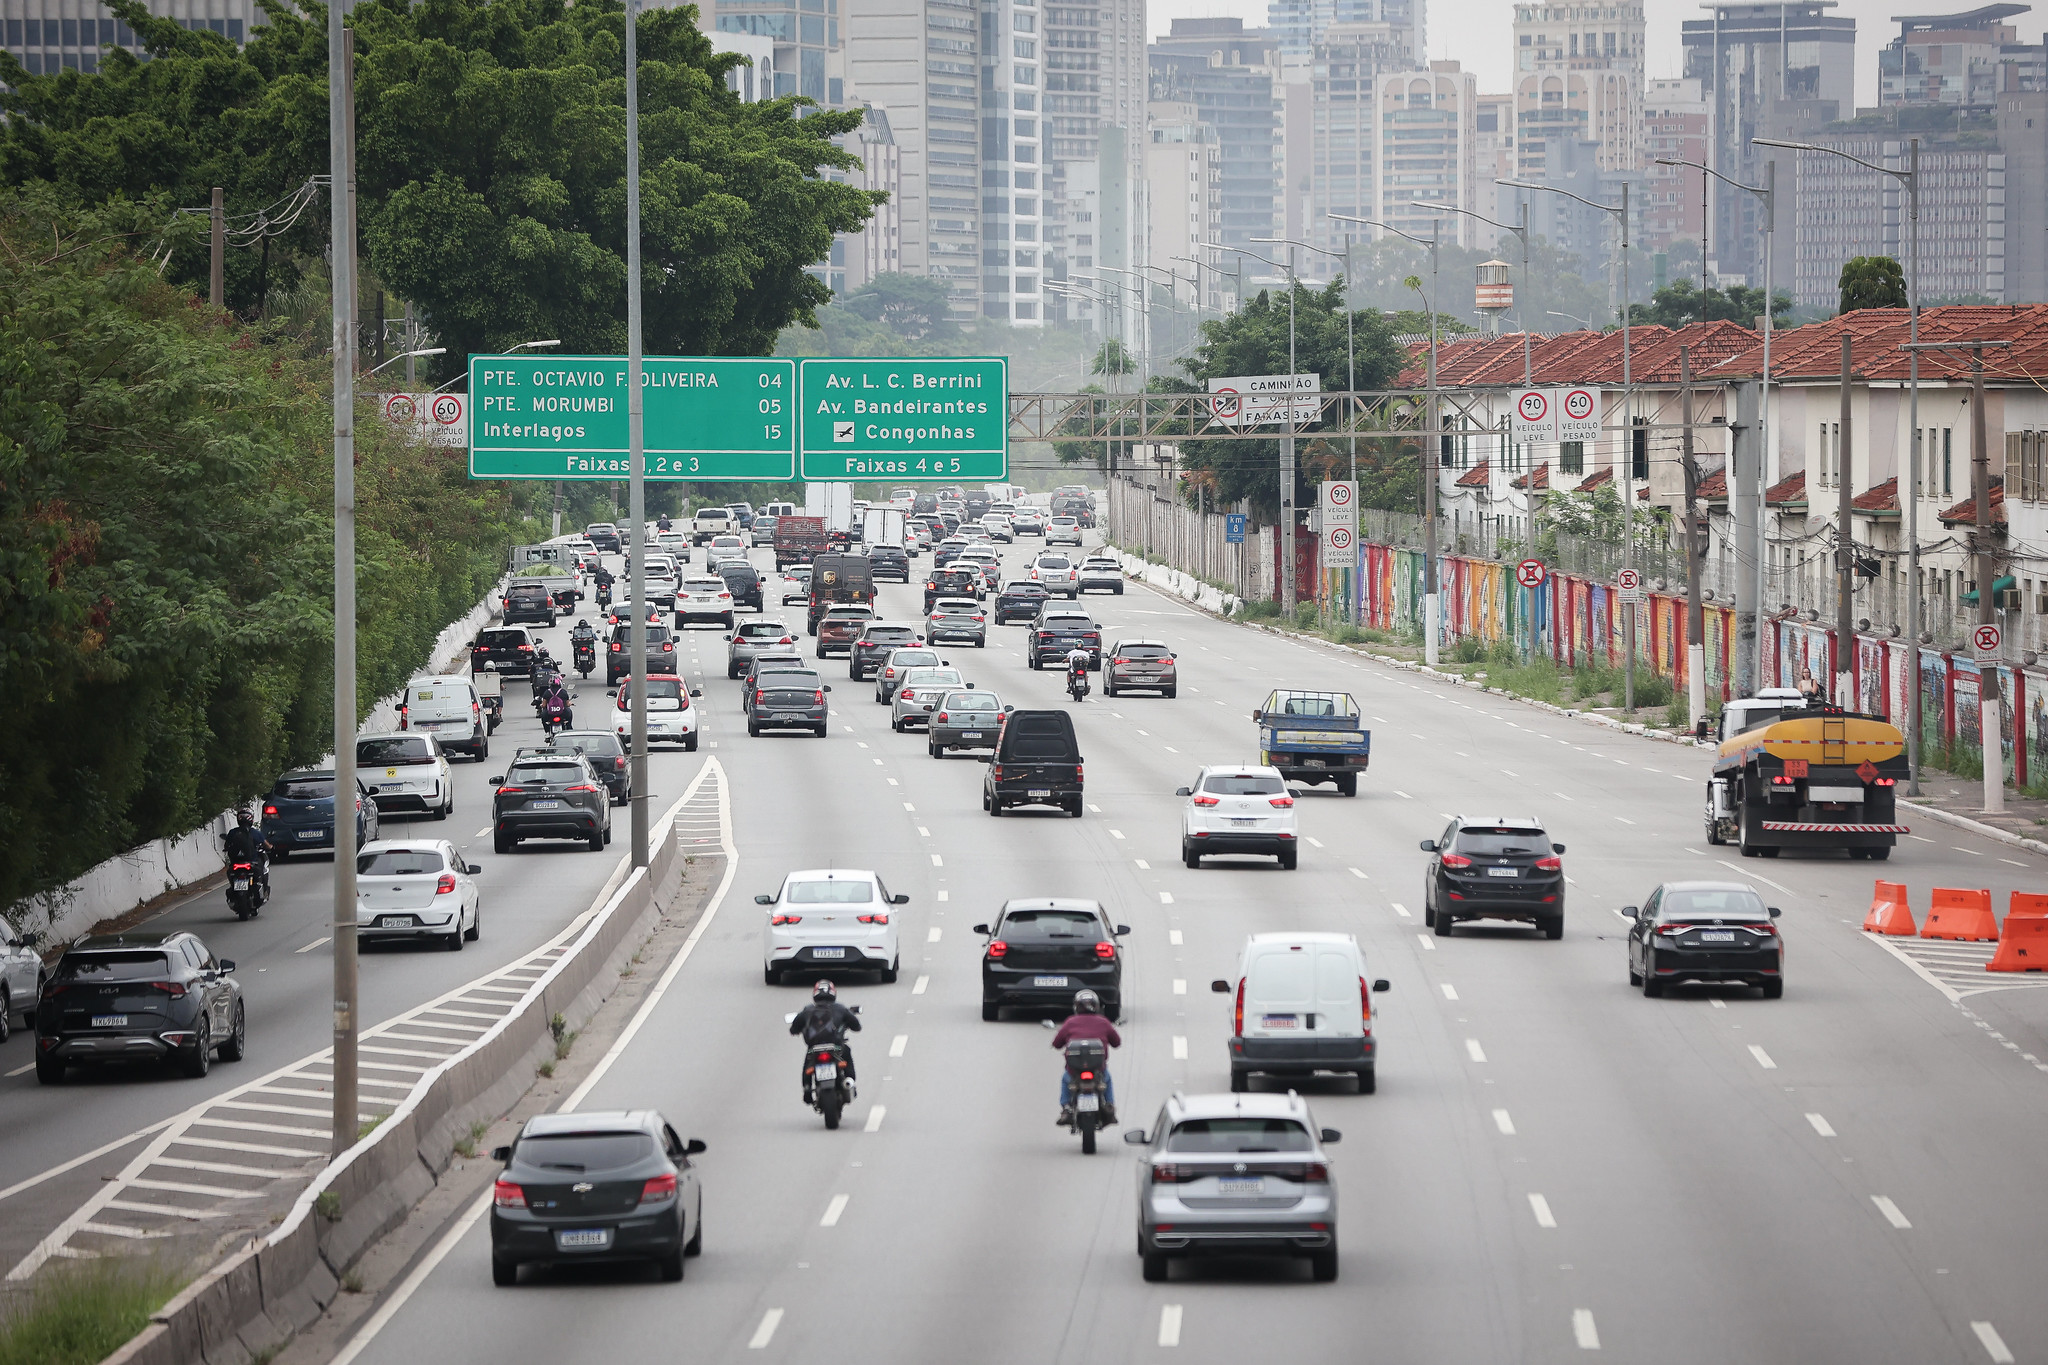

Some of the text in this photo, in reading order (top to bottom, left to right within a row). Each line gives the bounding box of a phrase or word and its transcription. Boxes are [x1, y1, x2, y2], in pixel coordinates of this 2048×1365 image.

[484, 371, 782, 388] PTE. OCTAVIO F. OLIVEIRA 04
[826, 373, 982, 389] Av. L. C. Berrini
[484, 396, 781, 414] PTE. MORUMBI 05
[816, 399, 988, 414] Av. Bandeirantes
[1525, 398, 1541, 410] 90
[1570, 396, 1587, 408] 60
[437, 402, 456, 415] 60
[1516, 422, 1553, 431] VEÍCULO
[1561, 420, 1598, 430] VEÍCULO
[484, 421, 782, 442] Interlagos 15
[865, 424, 976, 444] Congonhas
[1523, 433, 1545, 441] LEVE
[1563, 431, 1597, 440] PESADO
[566, 456, 630, 471] Faixas
[656, 457, 667, 472] 2
[672, 460, 683, 472] e
[689, 457, 699, 472] 3
[845, 457, 961, 473] Faixas 4 e 5
[1333, 489, 1347, 499] 90
[1233, 524, 1239, 532] 8
[1334, 533, 1348, 542] 60
